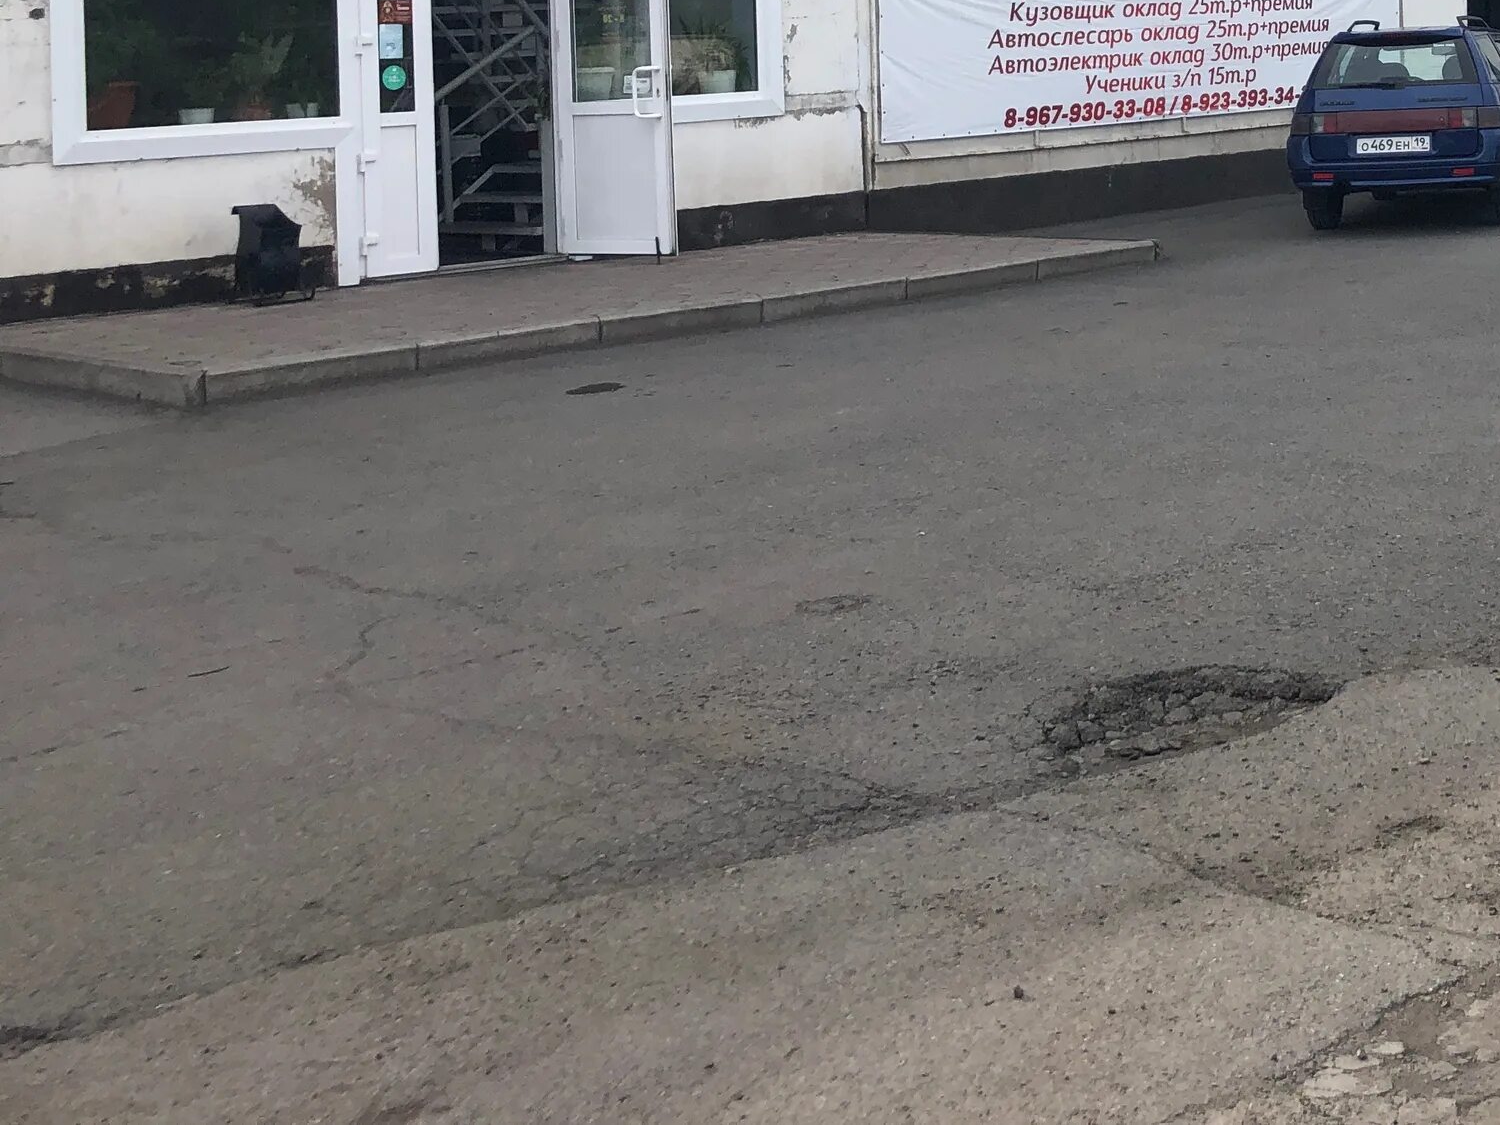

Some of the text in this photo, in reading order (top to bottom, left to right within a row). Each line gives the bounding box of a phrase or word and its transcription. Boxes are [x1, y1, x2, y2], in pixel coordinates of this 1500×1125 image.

[1009, 2, 1116, 26] Кузовщик
[1122, 1, 1182, 21] оклад
[987, 19, 1330, 49] Автослесарь оклад 25т.р+премия
[988, 51, 1144, 75] Автоэлектрик
[1150, 47, 1205, 68] оклад
[1085, 67, 1257, 94] Ученики з/п 15т.р
[1004, 96, 1166, 128] 8-967-930-33-08
[1180, 86, 1306, 114] 8-923-393-34-
[1361, 139, 1410, 151] О469ЕН
